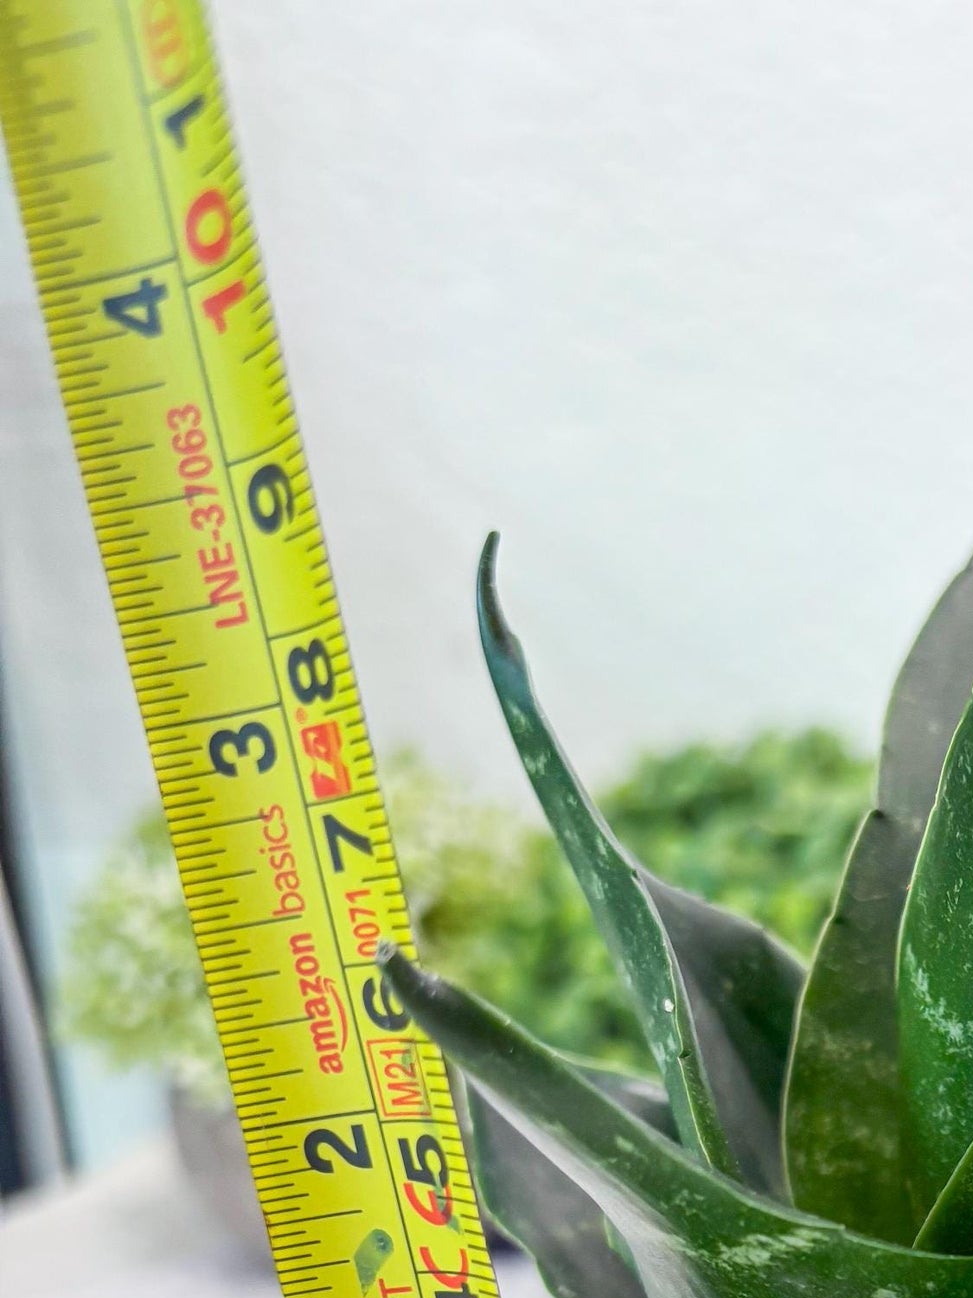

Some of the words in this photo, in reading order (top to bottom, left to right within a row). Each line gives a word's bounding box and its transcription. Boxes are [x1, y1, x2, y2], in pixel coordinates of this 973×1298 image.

[102, 278, 168, 338] 4
[167, 403, 249, 629] LNE-37063
[248, 463, 295, 534] 9
[287, 638, 335, 705] 8
[209, 722, 276, 778] 3
[258, 803, 306, 919] basics
[321, 813, 374, 873] 7
[344, 889, 382, 958] 0071
[289, 932, 349, 1075] amazon
[363, 975, 411, 1032] 6
[384, 1047, 424, 1112] M21
[304, 1124, 374, 1174] 2
[399, 1133, 449, 1186] 5
